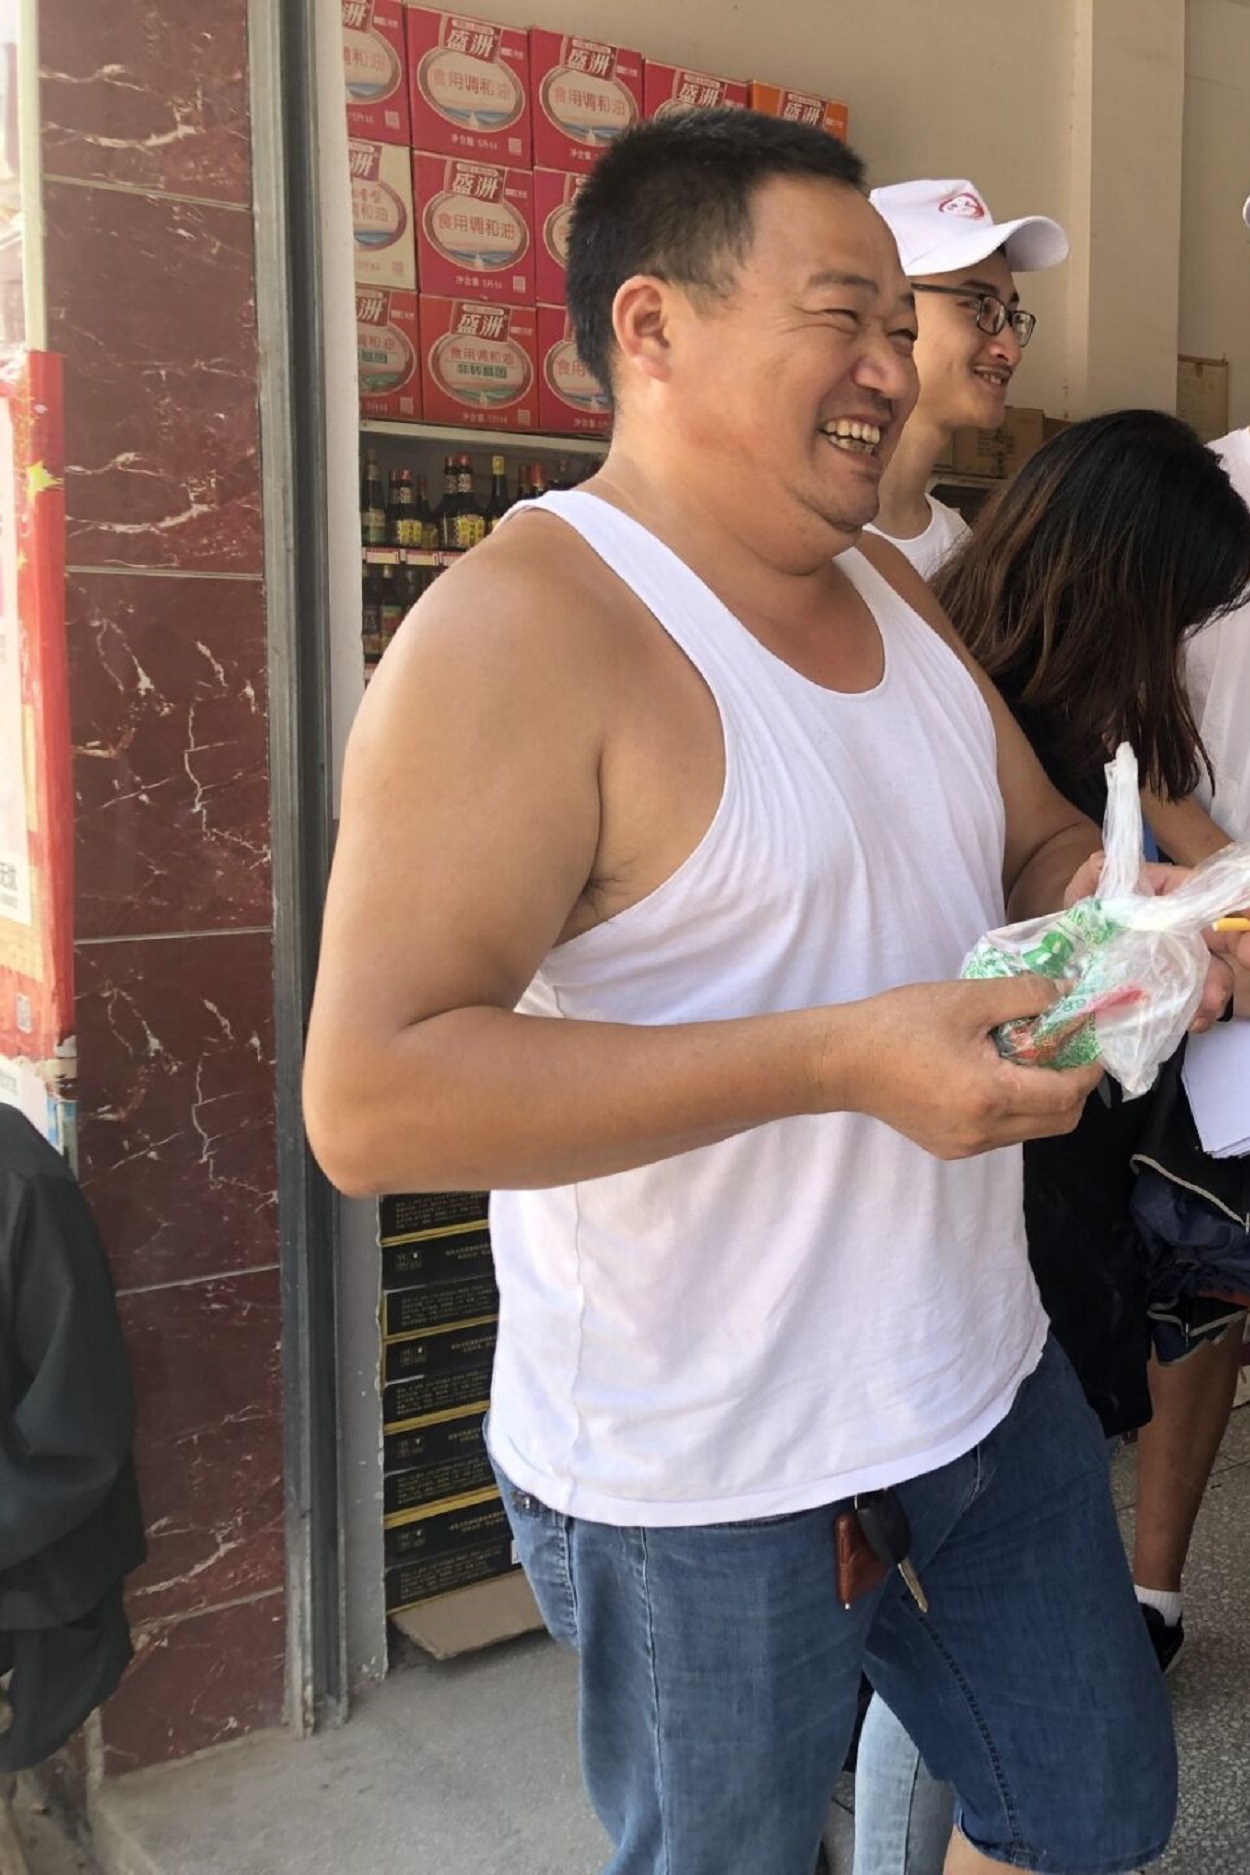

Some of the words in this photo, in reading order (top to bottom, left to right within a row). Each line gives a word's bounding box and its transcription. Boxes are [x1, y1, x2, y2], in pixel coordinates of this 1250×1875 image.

[447, 29, 494, 57] 盛洲
[567, 49, 610, 77] 盛洲
[452, 173, 499, 200] 盛洲
[438, 212, 516, 241] 食用调和油
[456, 313, 505, 338] 盛洲
